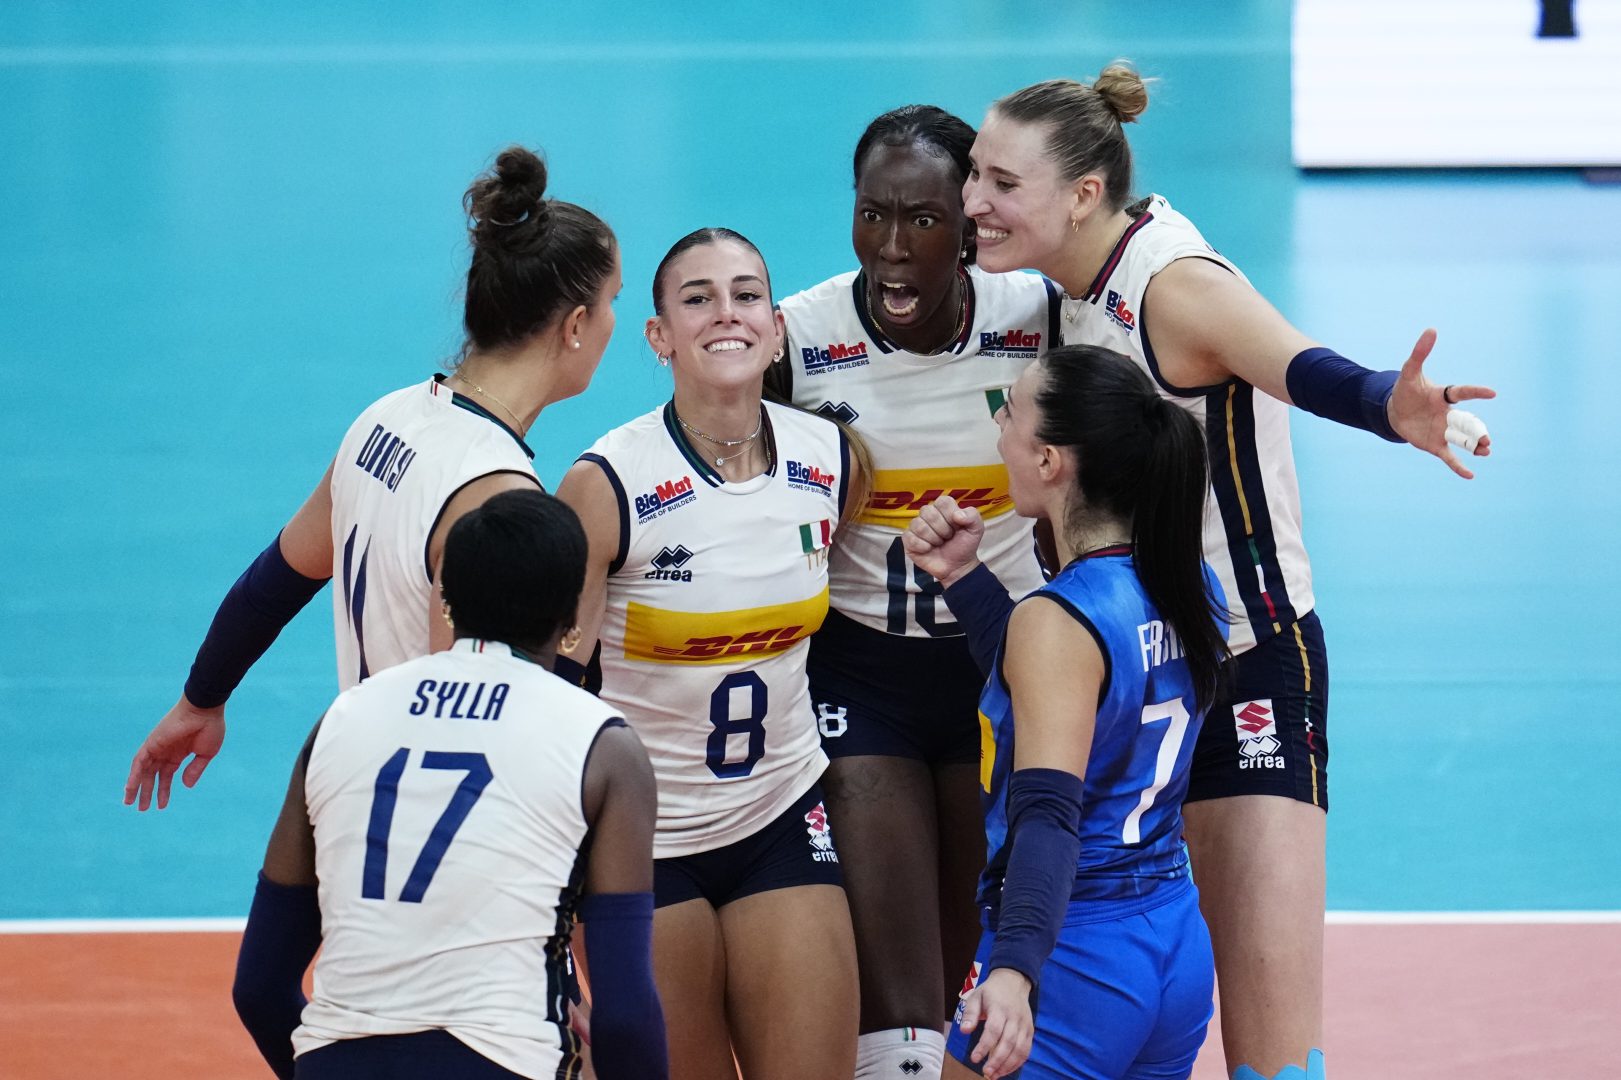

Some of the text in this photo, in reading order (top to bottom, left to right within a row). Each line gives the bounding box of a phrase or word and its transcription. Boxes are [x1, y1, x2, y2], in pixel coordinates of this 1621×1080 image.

[801, 341, 867, 366] BigMat
[980, 329, 1042, 350] BigMat
[806, 367, 827, 376] HOME
[838, 359, 870, 371] BUILDERS
[786, 460, 835, 488] BigMat
[634, 475, 693, 515] BigMat
[638, 494, 697, 525] HOME OF BUILDERS
[644, 569, 692, 583] errea
[680, 625, 805, 657] DHL
[409, 679, 510, 721] SYLLA
[705, 670, 768, 779] 8
[1122, 697, 1190, 845] 7
[1238, 755, 1286, 769] errea
[361, 747, 494, 904] 17
